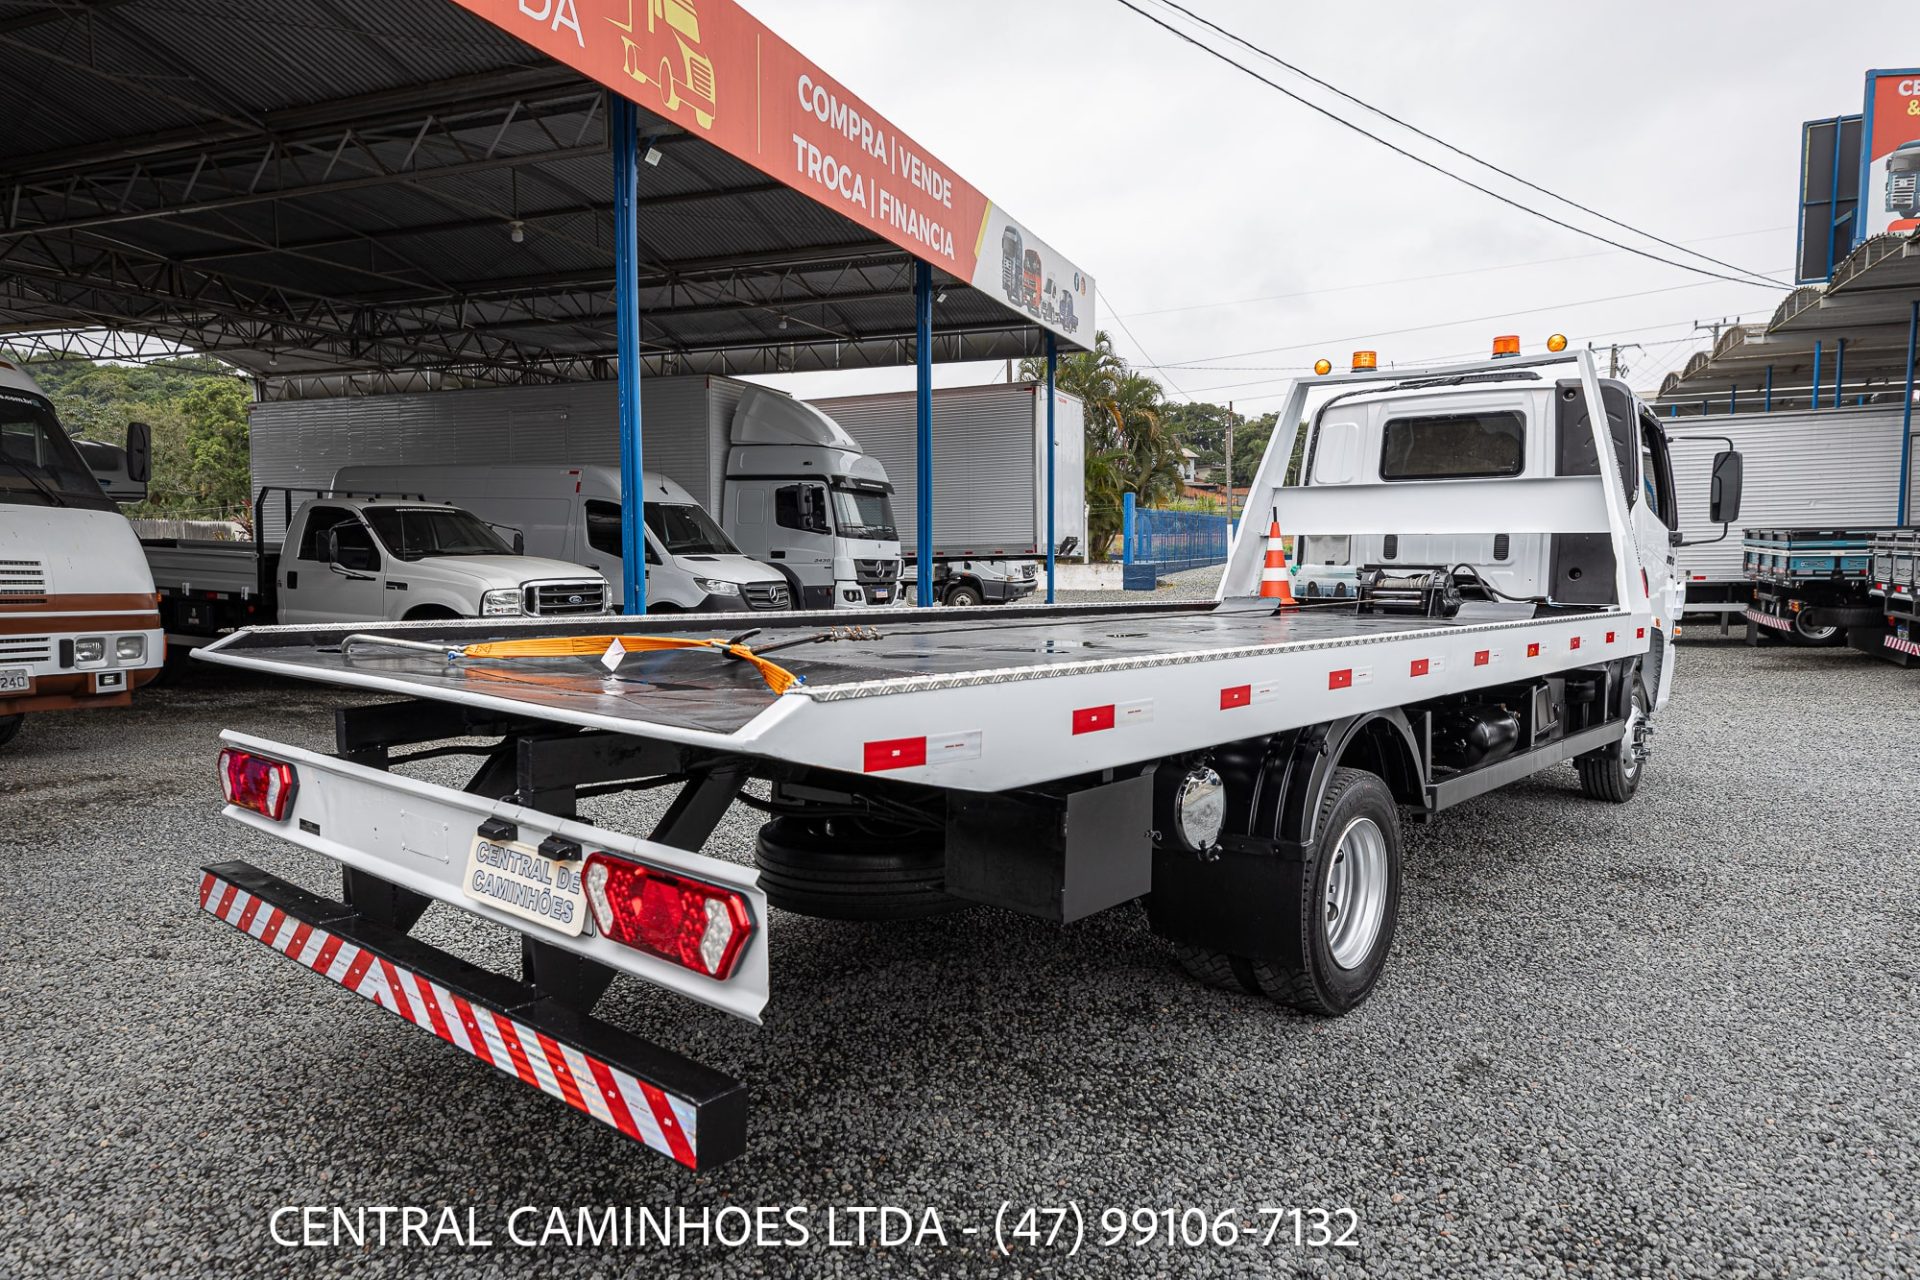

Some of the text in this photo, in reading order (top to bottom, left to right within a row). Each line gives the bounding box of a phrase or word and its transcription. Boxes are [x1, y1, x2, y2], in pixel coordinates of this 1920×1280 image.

[797, 74, 888, 166] COMPRA
[899, 146, 952, 208] VENDE
[792, 133, 867, 209] TROCA
[879, 188, 955, 261] FINANCIA
[472, 870, 574, 923] CAMINHÕES
[476, 841, 552, 885] CENTRAL
